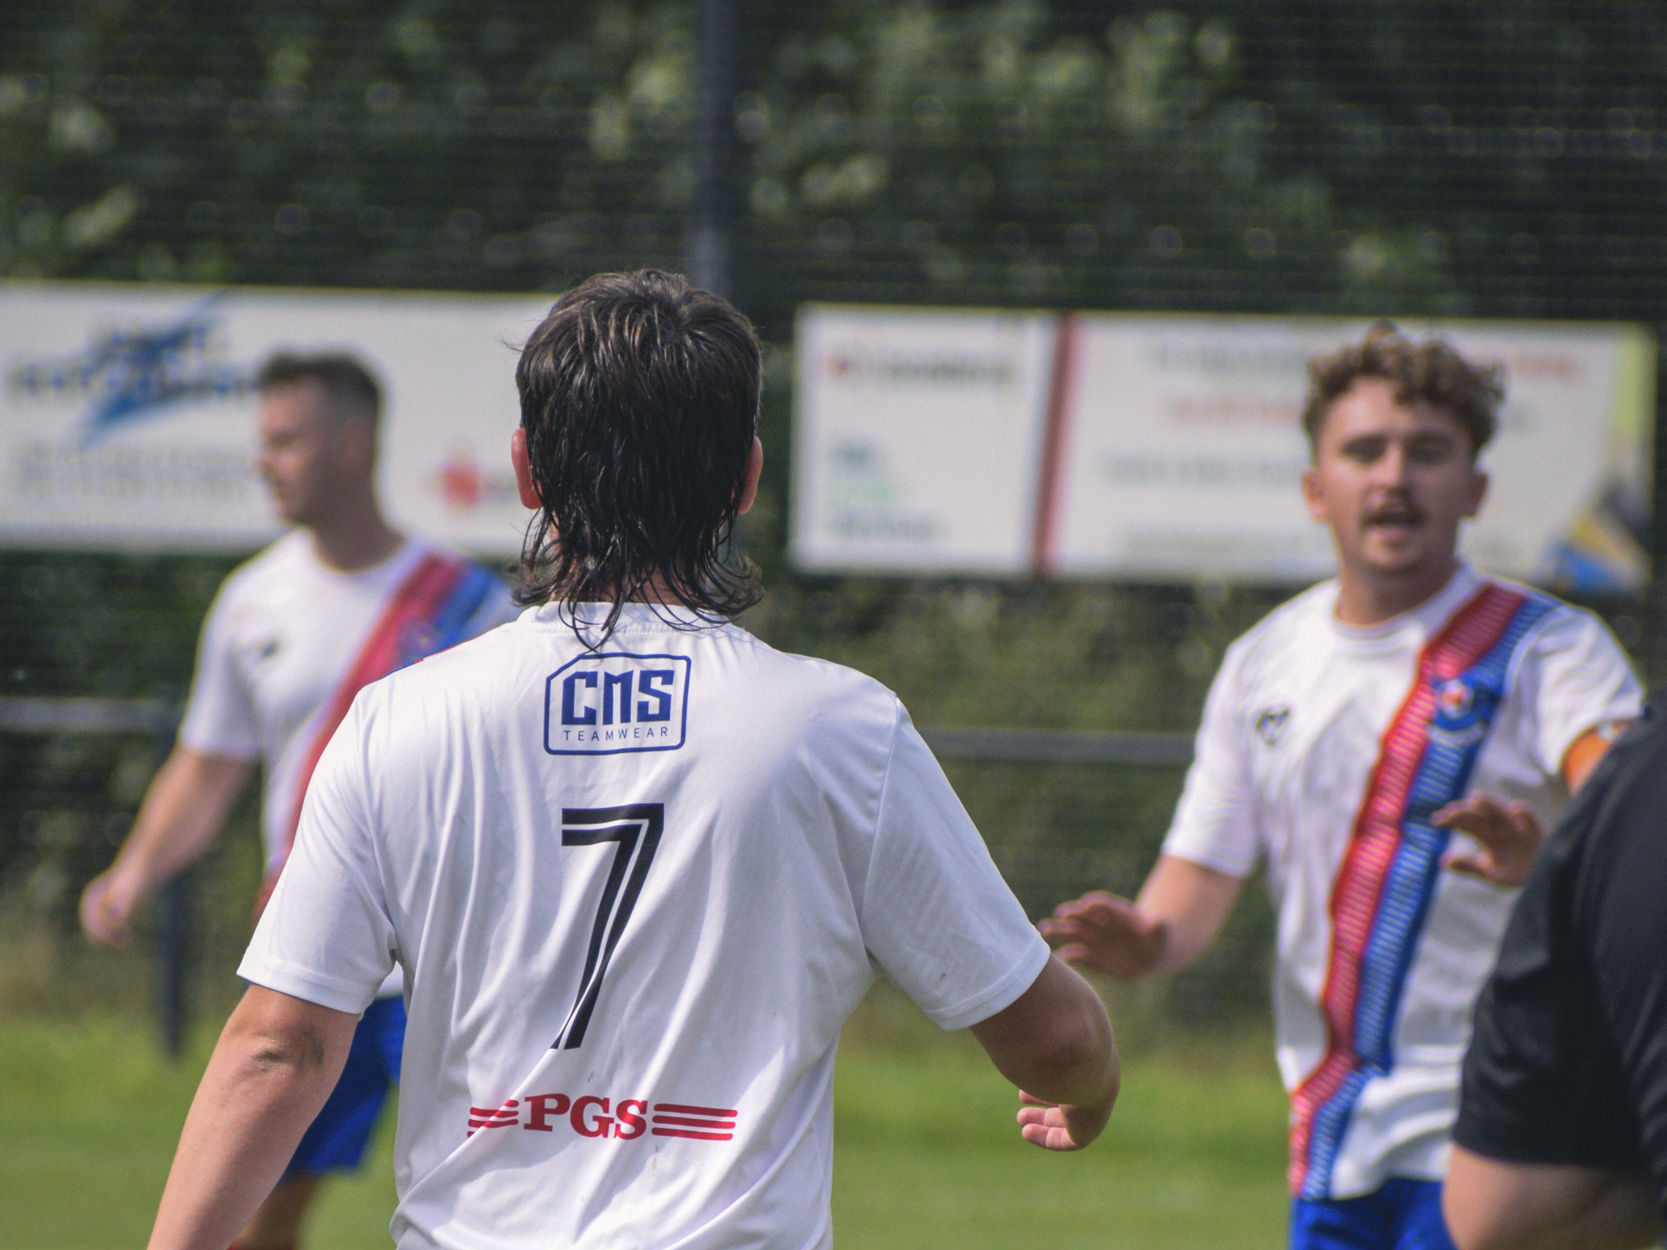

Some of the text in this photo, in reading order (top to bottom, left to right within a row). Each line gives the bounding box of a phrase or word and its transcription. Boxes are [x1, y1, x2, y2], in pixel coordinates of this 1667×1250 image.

[561, 670, 675, 725] CMS
[563, 726, 668, 741] TEAMWEAR
[549, 802, 665, 1050] 7
[523, 1093, 648, 1140] PGS
